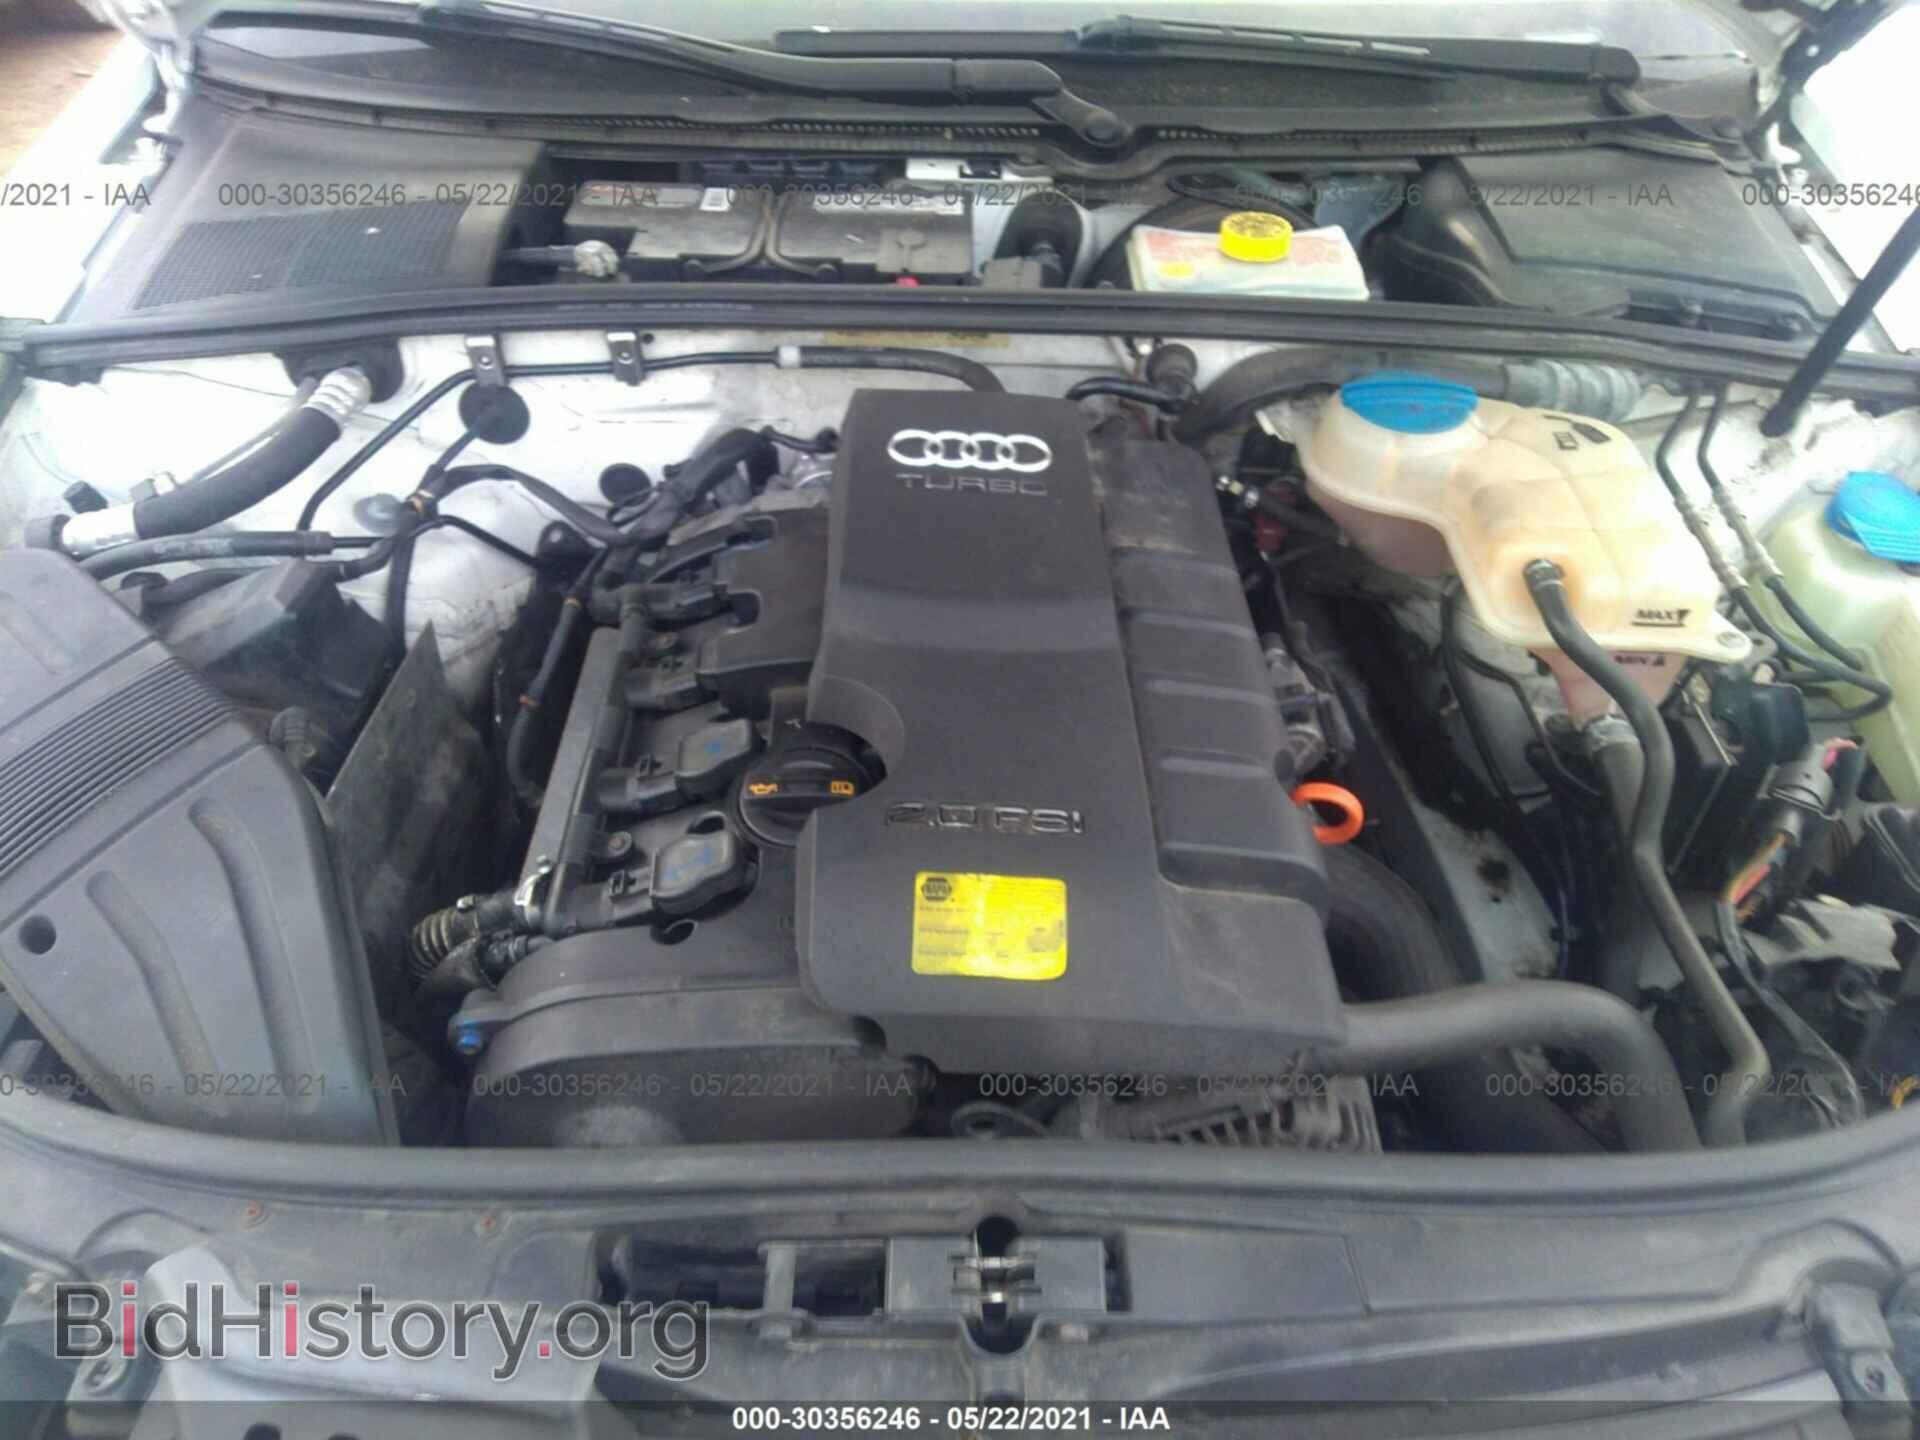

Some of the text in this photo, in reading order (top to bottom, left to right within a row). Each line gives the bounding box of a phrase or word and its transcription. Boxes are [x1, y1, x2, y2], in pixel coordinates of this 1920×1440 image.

[896, 473, 1048, 496] TURBO
[885, 802, 1085, 834] 2.0 FSI
